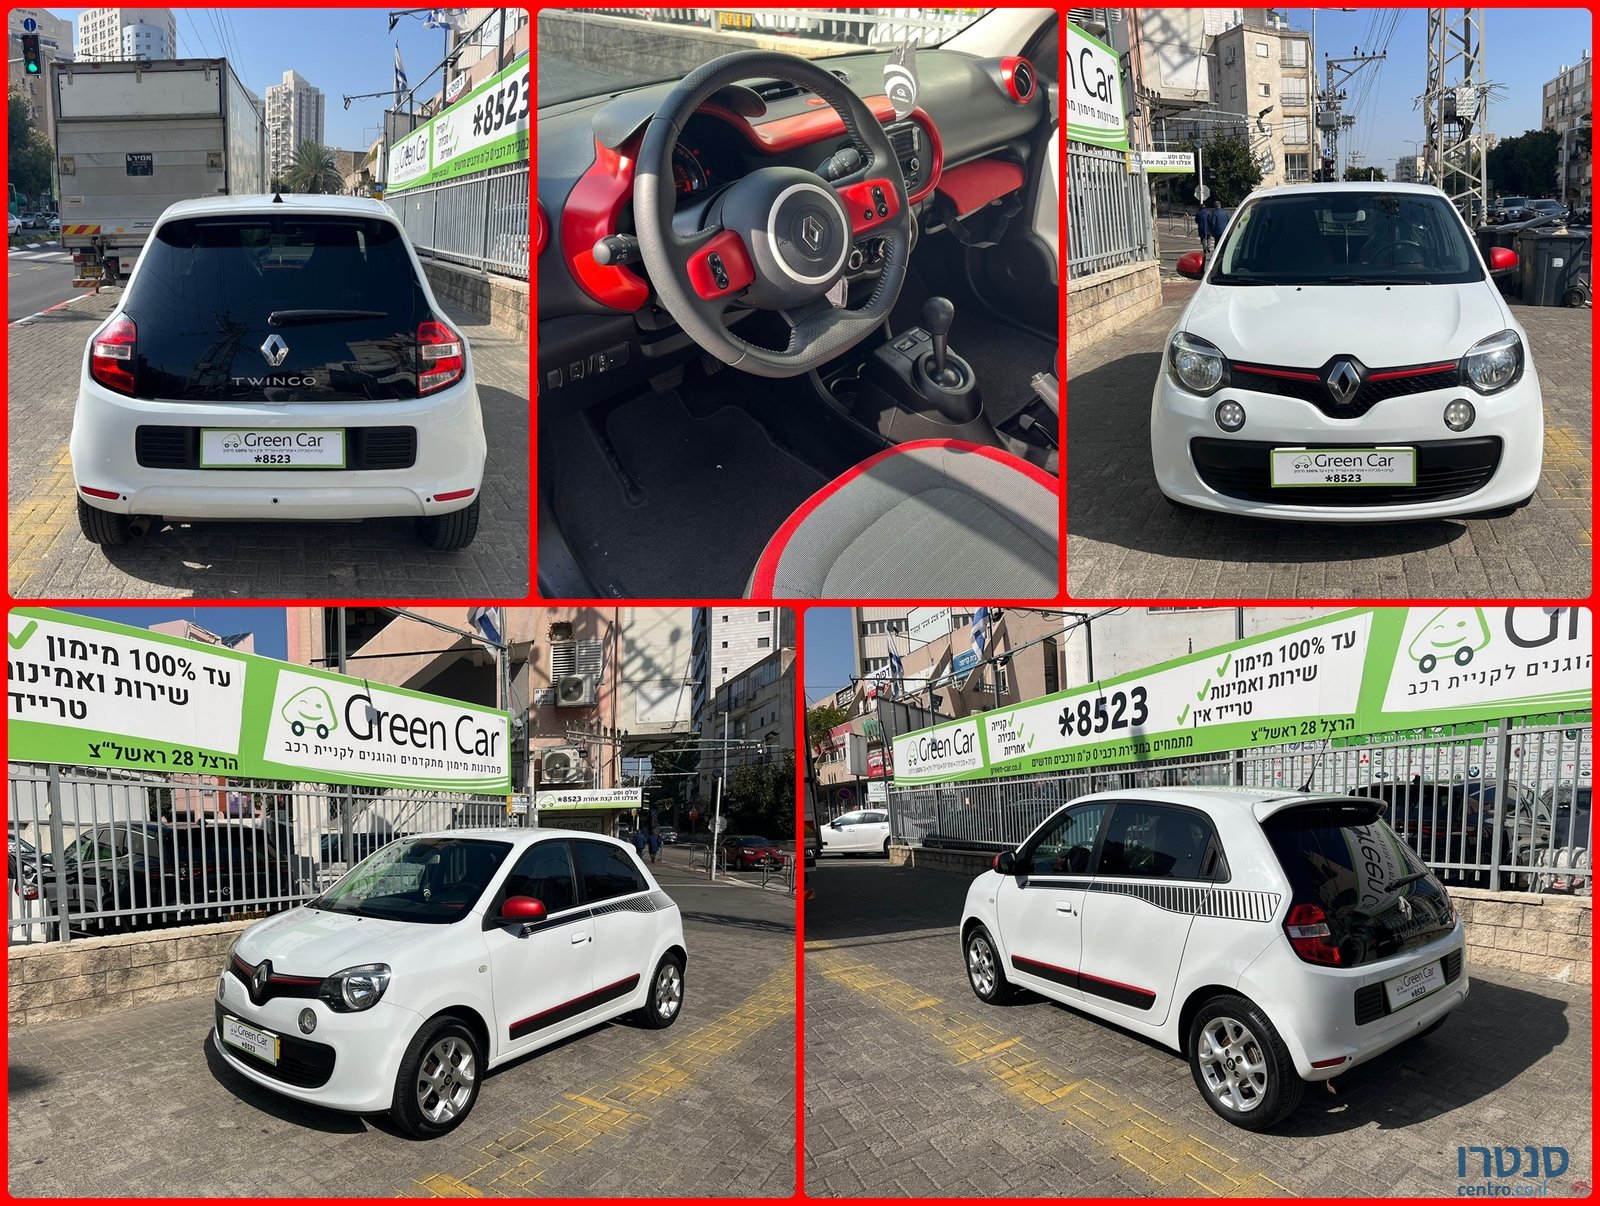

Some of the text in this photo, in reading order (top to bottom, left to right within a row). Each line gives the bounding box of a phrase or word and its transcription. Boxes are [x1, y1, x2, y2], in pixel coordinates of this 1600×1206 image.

[1080, 47, 1114, 105] Car
[1078, 102, 1095, 116] מימון
[1097, 109, 1120, 126] פתרונות
[400, 135, 428, 169] Green Car
[231, 377, 317, 386] TWINGO
[244, 432, 323, 447] Green Car
[1315, 454, 1394, 467] Green Car
[46, 635, 231, 688] עד 100% מימון
[1234, 630, 1356, 678] עד 100% מימון
[1210, 664, 1318, 701] שירות ואמינות
[1448, 664, 1515, 690] לקניית
[114, 677, 188, 706] שירות
[1408, 680, 1439, 696] רכב
[8, 692, 87, 719] טרייד
[1193, 701, 1252, 727] טרייד אין
[345, 694, 500, 757] Green Car
[992, 719, 1006, 731] קנייה
[1251, 717, 1355, 741] הרצל 28 ראשל"צ
[919, 728, 974, 761] Green Car
[998, 731, 1016, 743] מכירה
[1154, 735, 1193, 752] מתמחים
[172, 750, 193, 766] 28
[285, 741, 501, 775] פתרונות מימון מתקדמים והוגנים לקניית רכב
[1004, 743, 1025, 756] אחריות
[1100, 747, 1117, 759] רכבי
[1119, 744, 1151, 757] במכירת
[199, 752, 239, 770] הרצל
[1031, 755, 1053, 768] חדשים
[1054, 754, 1076, 765] ורכבים
[990, 762, 1022, 775] green-car.co.il
[584, 821, 599, 829] Car
[1403, 972, 1423, 986] Green
[1423, 968, 1433, 978] Car
[238, 1026, 256, 1041] Green
[257, 1034, 267, 1046] Car
